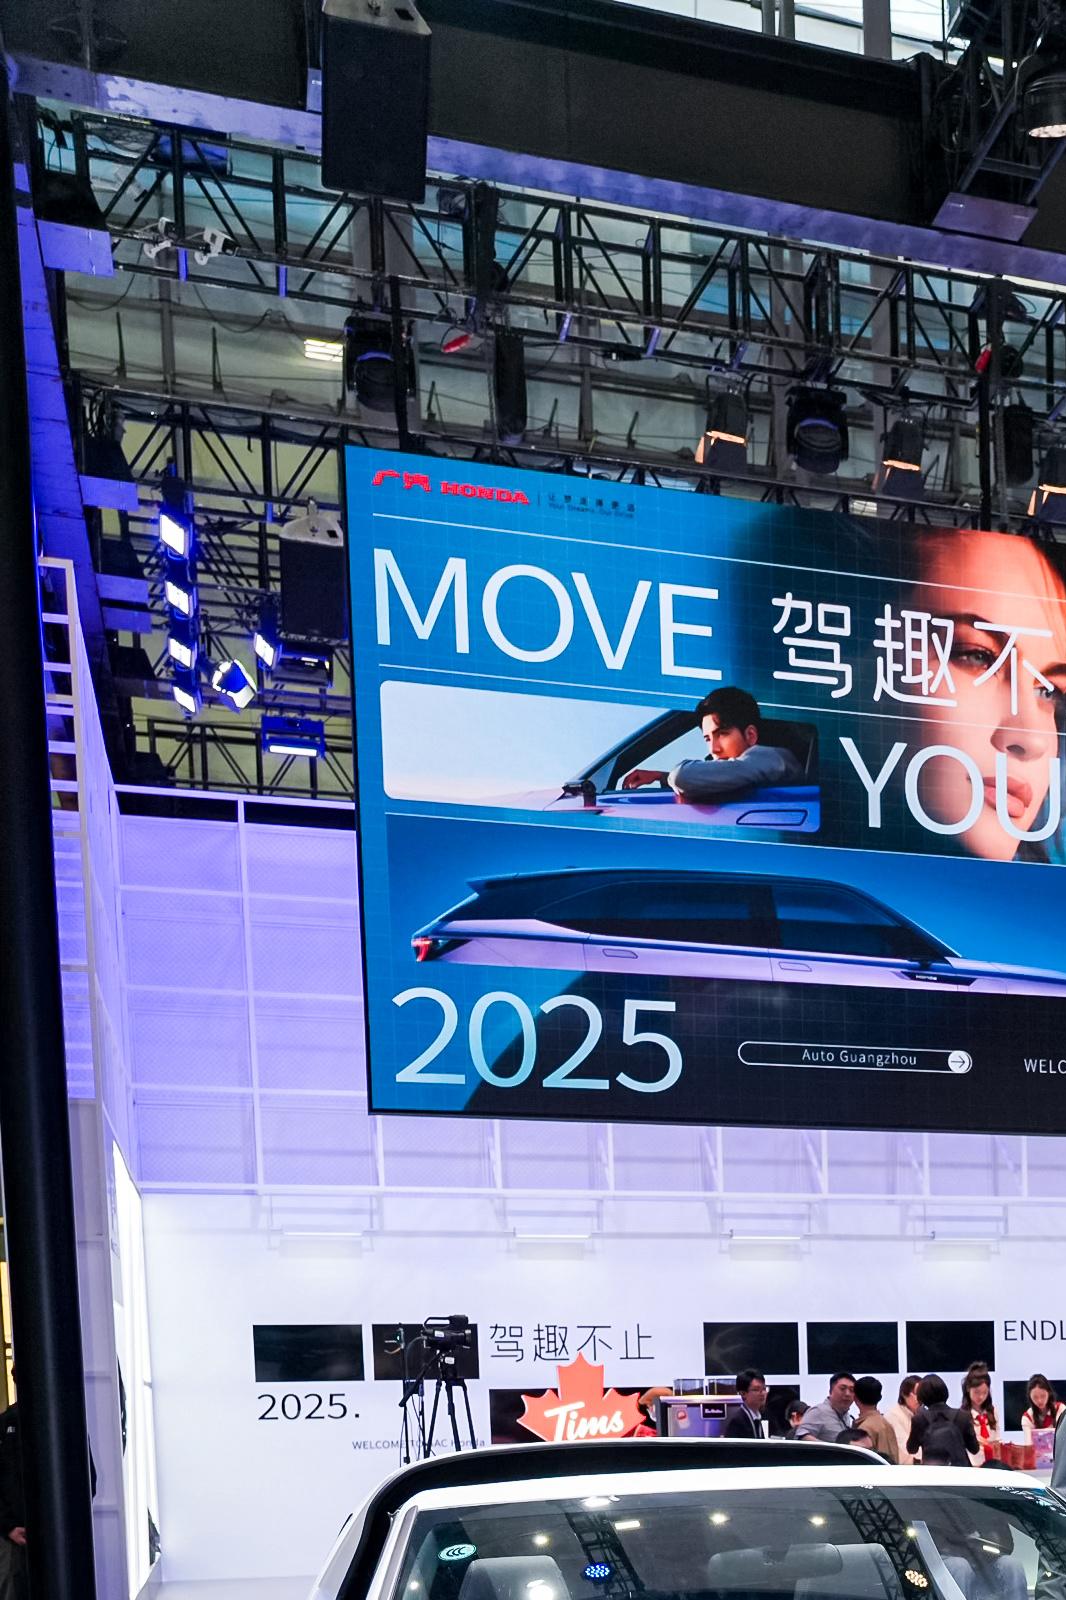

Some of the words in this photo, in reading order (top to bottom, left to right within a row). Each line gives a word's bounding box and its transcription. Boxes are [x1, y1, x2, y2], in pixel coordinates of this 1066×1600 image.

[440, 481, 530, 506] HONDA
[375, 548, 722, 681] MOVE
[392, 987, 683, 1093] 2025
[802, 1049, 835, 1062] Auto
[839, 1050, 917, 1067] Guangzhou
[489, 1323, 655, 1362] 驾趣不止
[257, 1393, 360, 1420] 2025.
[543, 1401, 624, 1440] Tims
